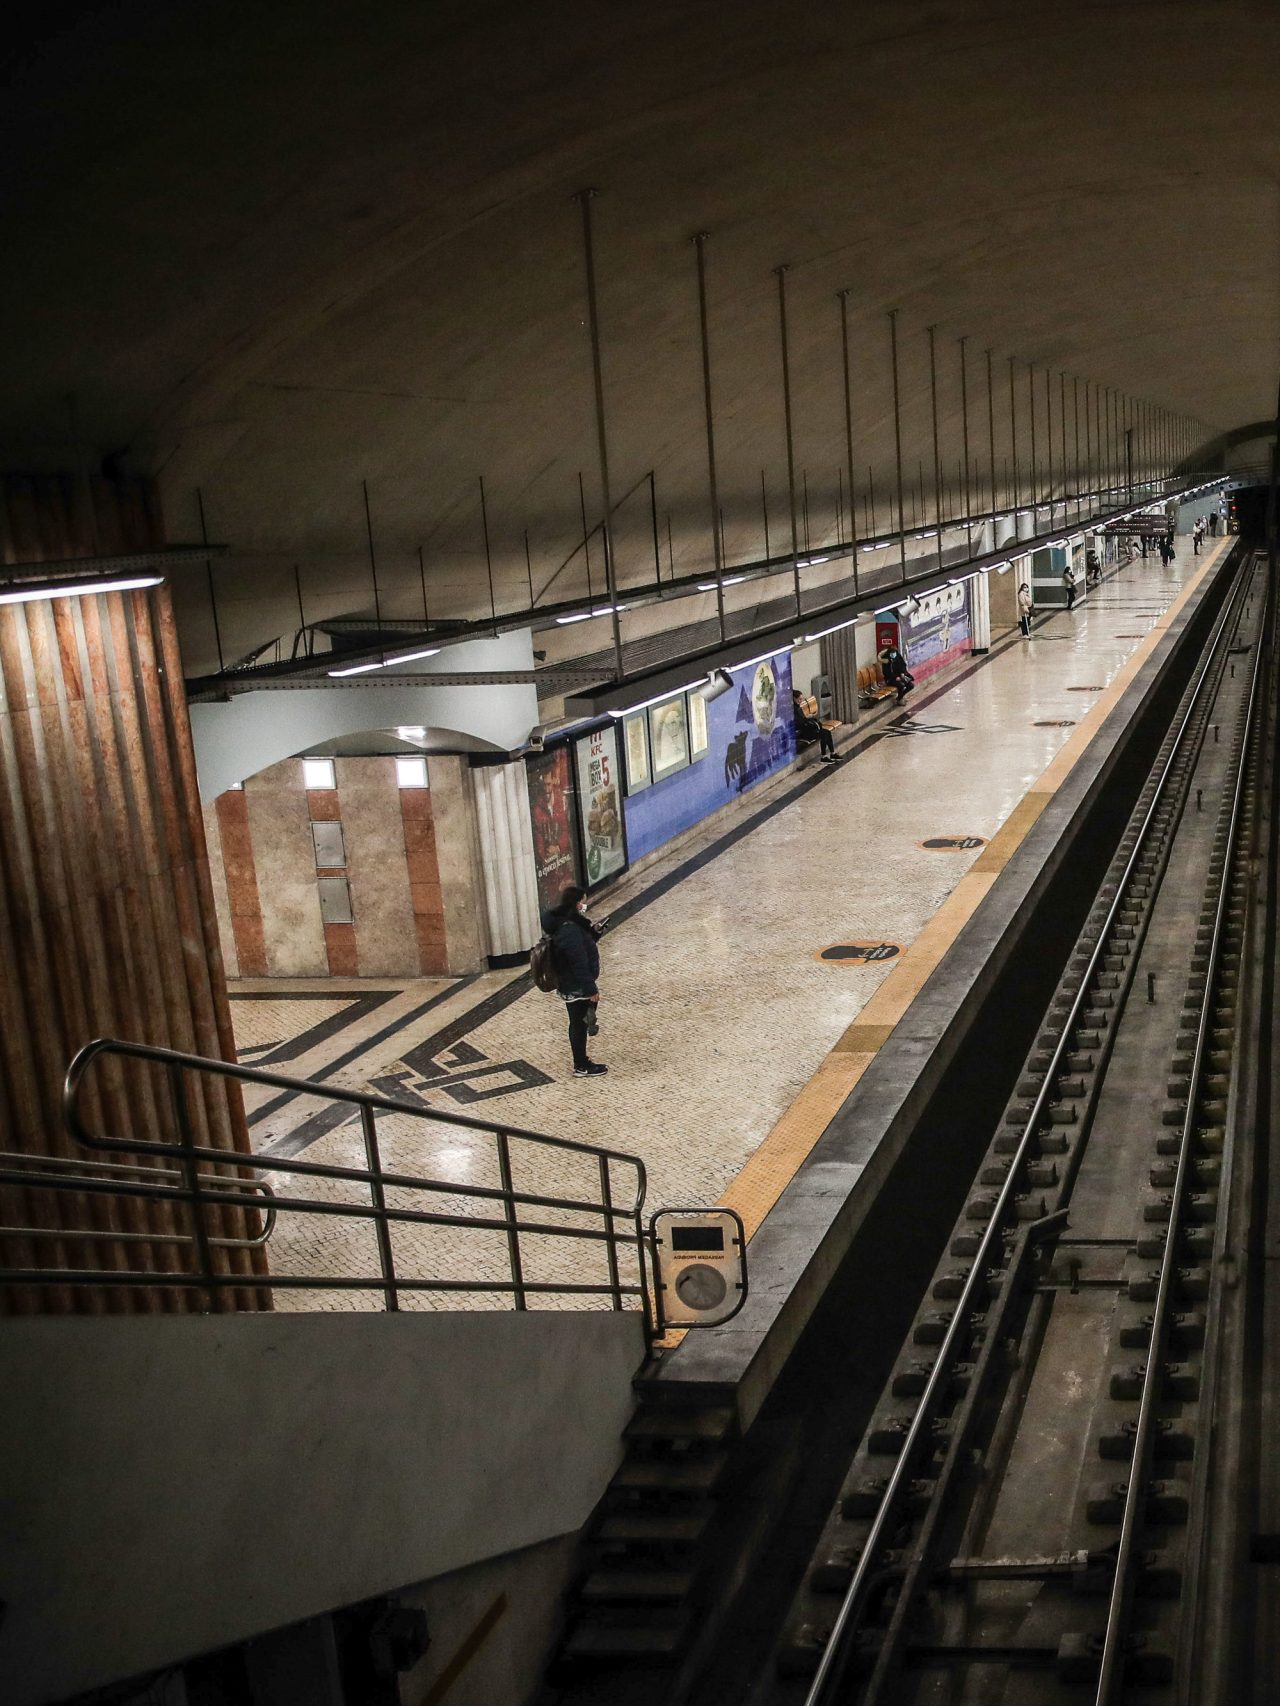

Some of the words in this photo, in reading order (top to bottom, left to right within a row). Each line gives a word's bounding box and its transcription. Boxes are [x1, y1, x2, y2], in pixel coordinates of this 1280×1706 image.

[590, 743, 603, 757] KFC
[591, 770, 602, 787] BOX
[601, 755, 610, 787] 5
